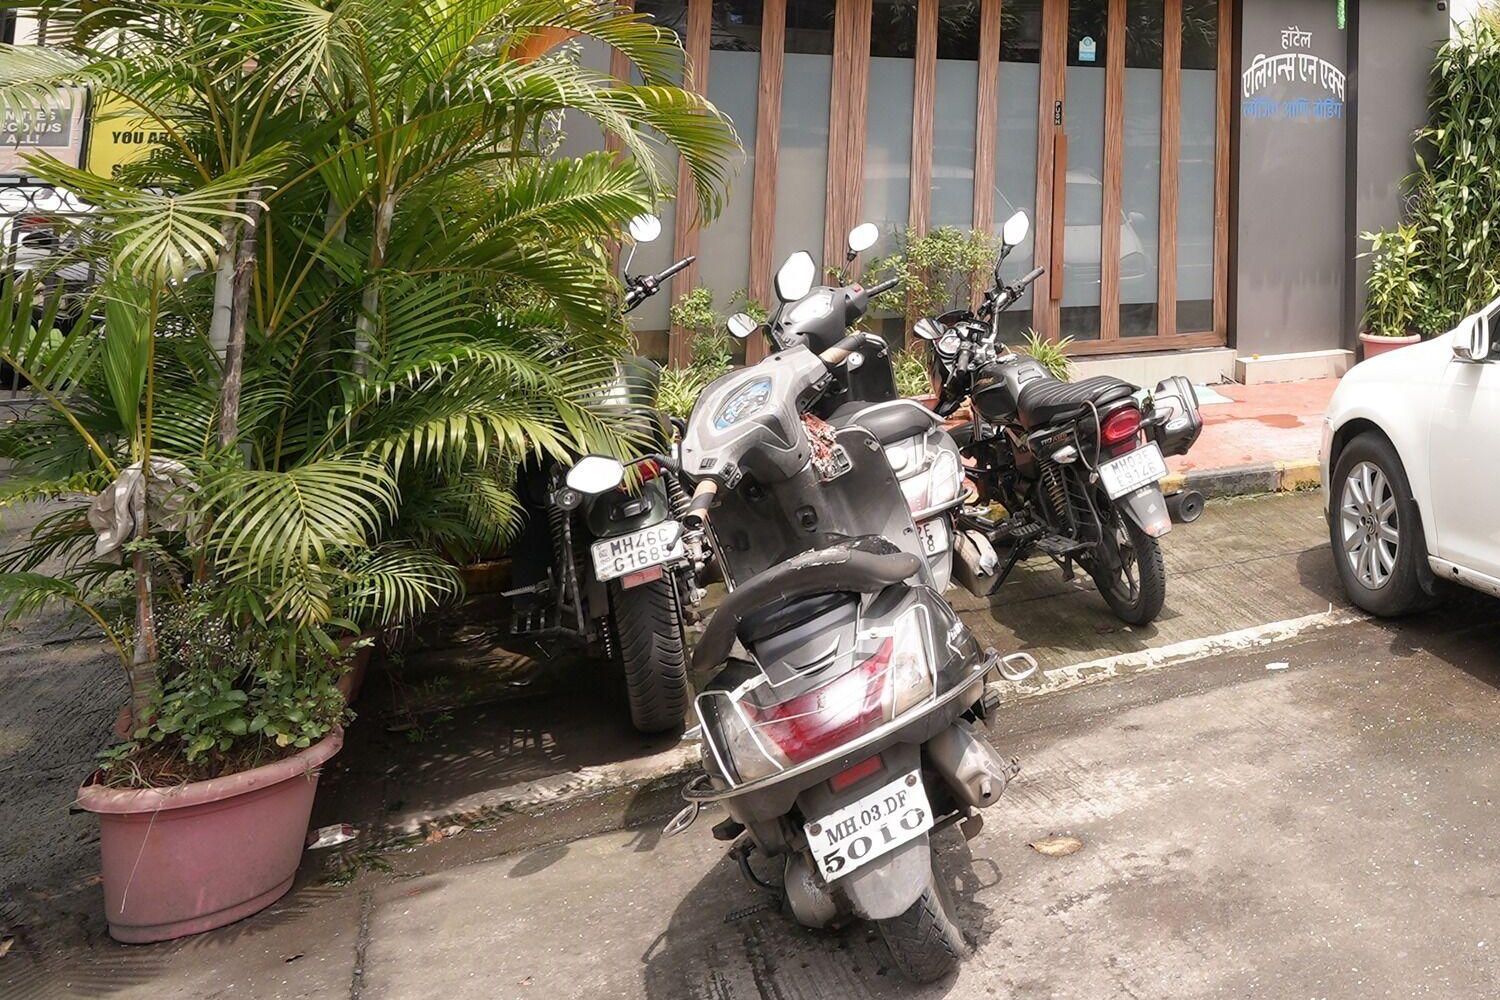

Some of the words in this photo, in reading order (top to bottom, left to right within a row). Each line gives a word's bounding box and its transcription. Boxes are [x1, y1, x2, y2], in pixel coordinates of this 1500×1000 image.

[1281, 25, 1312, 49] हॉटेल
[1243, 53, 1297, 98] एलिगन्स
[1298, 53, 1319, 84] एन
[1319, 59, 1346, 102] एक्स
[112, 131, 144, 144] YOU
[823, 808, 925, 873] 5010
